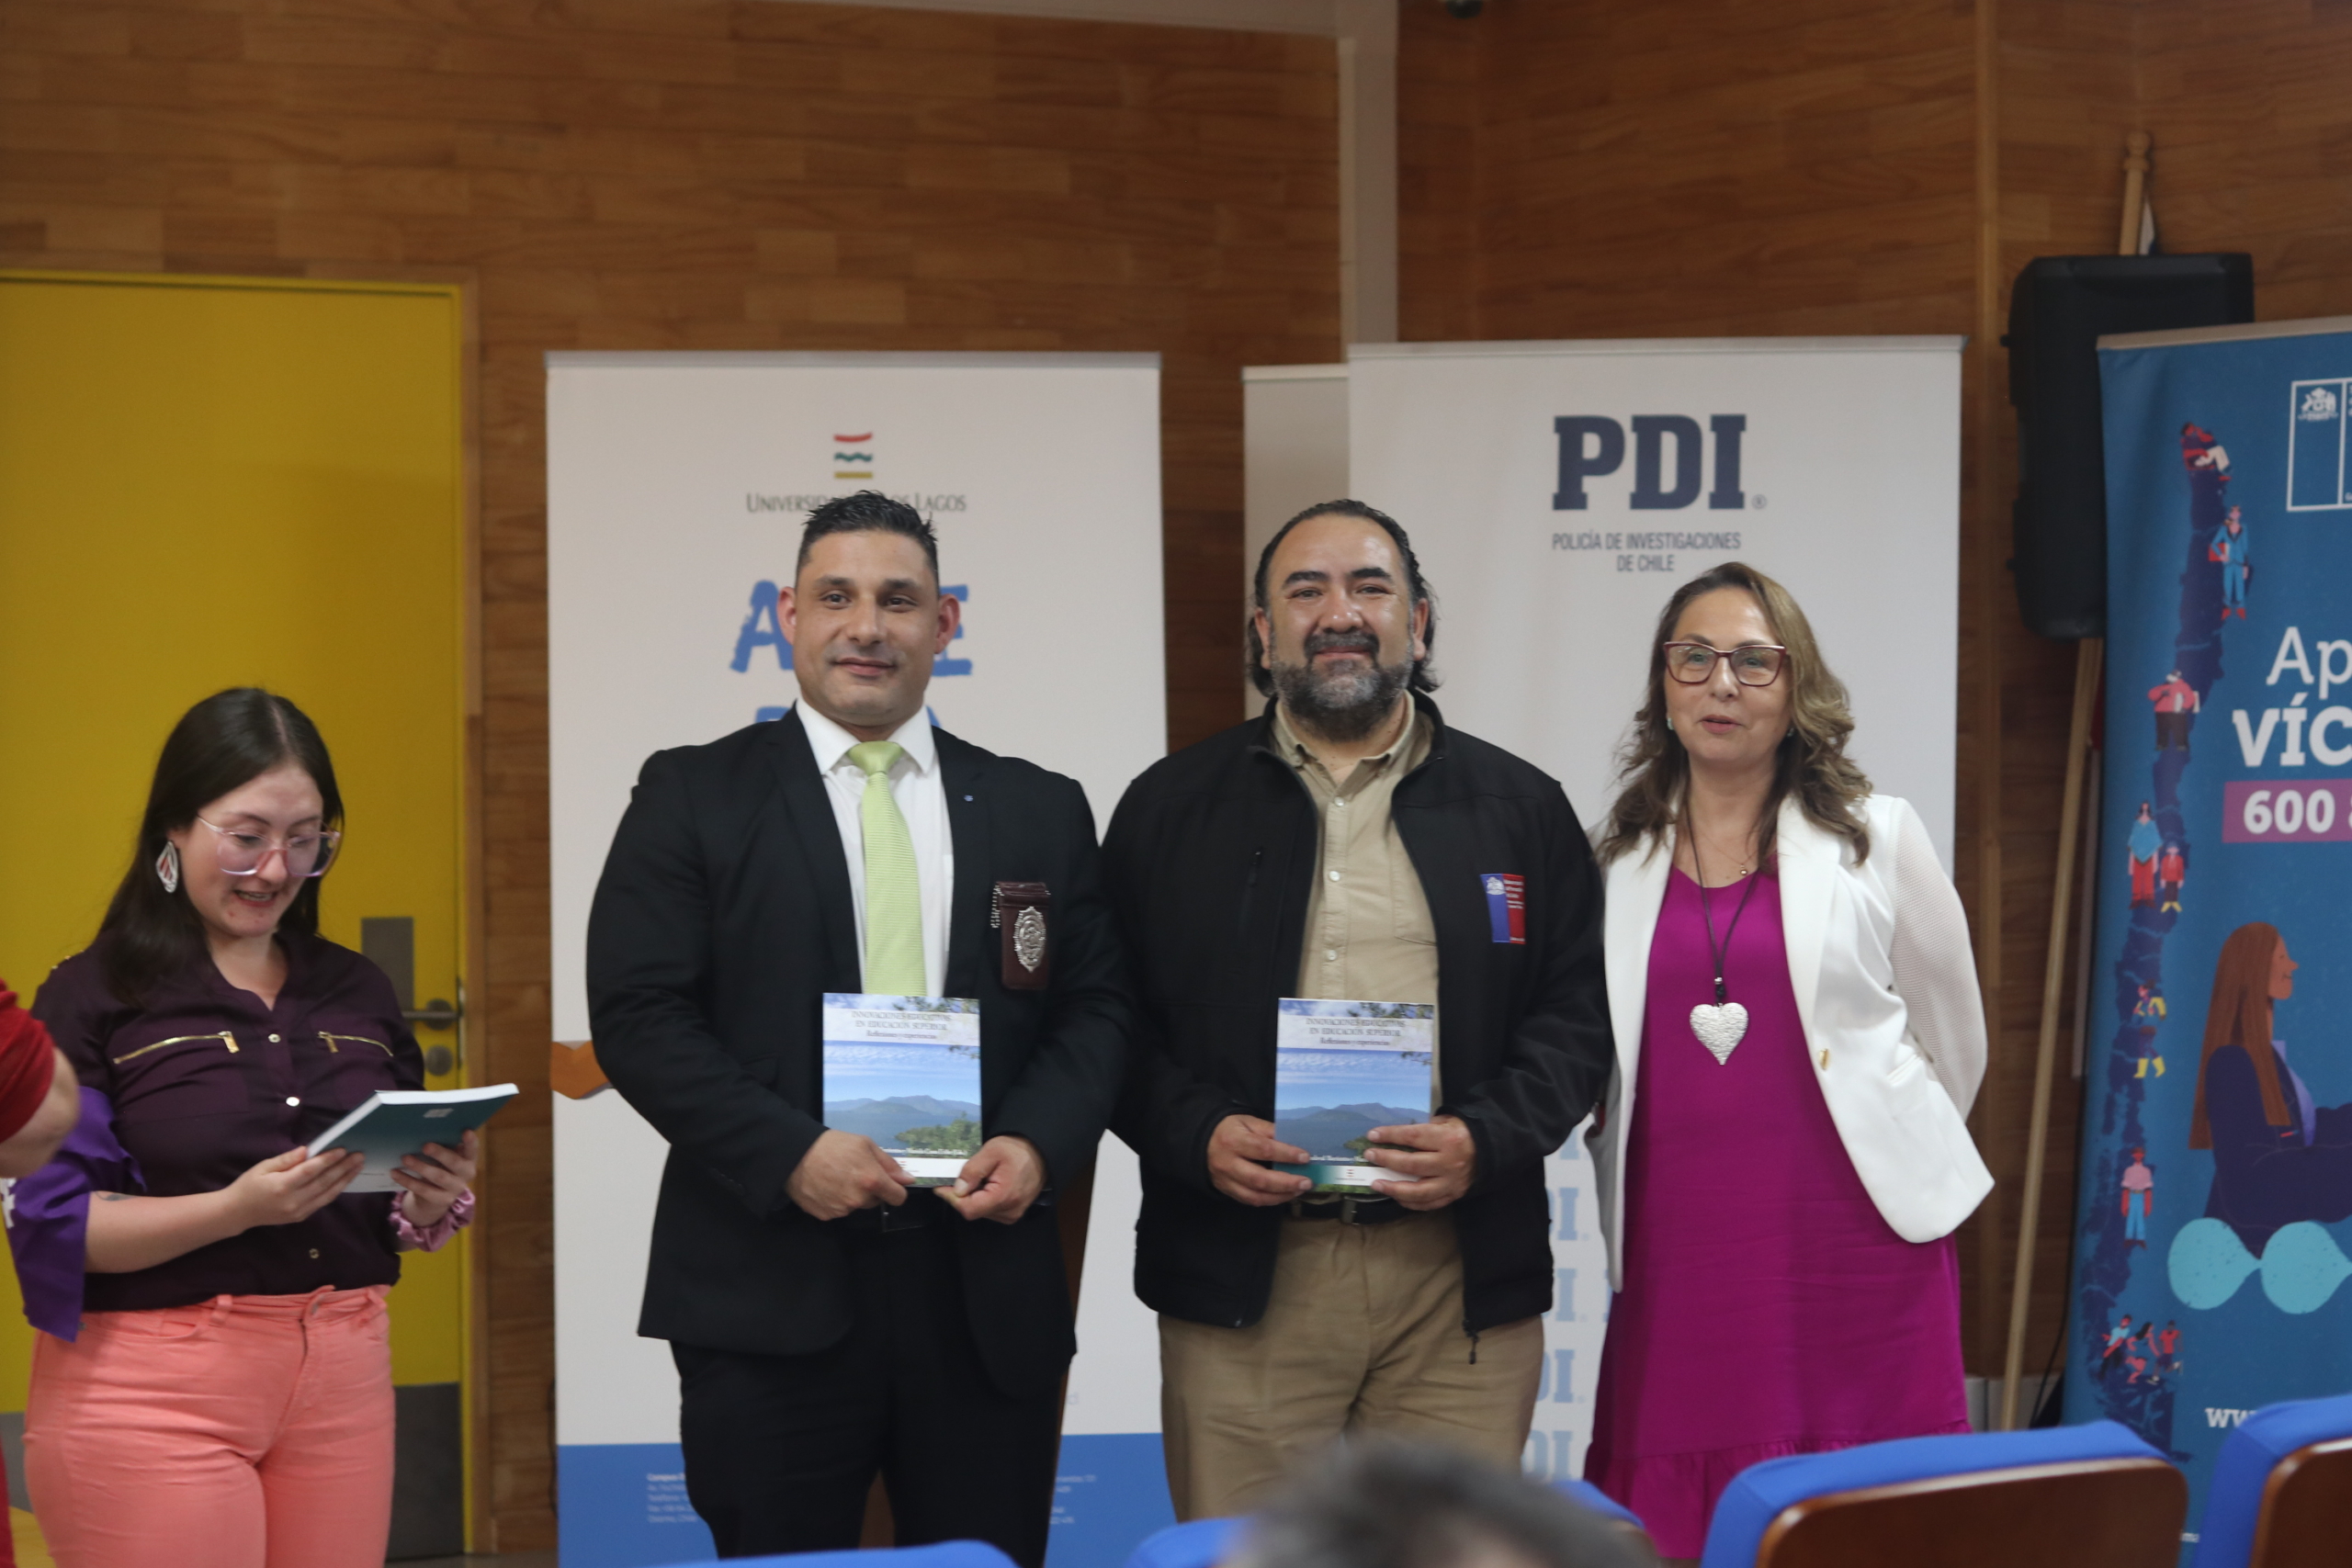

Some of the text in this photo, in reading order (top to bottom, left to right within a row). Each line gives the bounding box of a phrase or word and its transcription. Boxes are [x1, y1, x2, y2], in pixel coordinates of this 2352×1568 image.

[1553, 414, 1747, 510] PDI
[915, 493, 967, 512] LAGOS
[1553, 528, 1741, 550] POLICÍA DE INVESTIGACIONES
[1617, 555, 1674, 571] DE CHILE
[2244, 789, 2335, 834] 600
